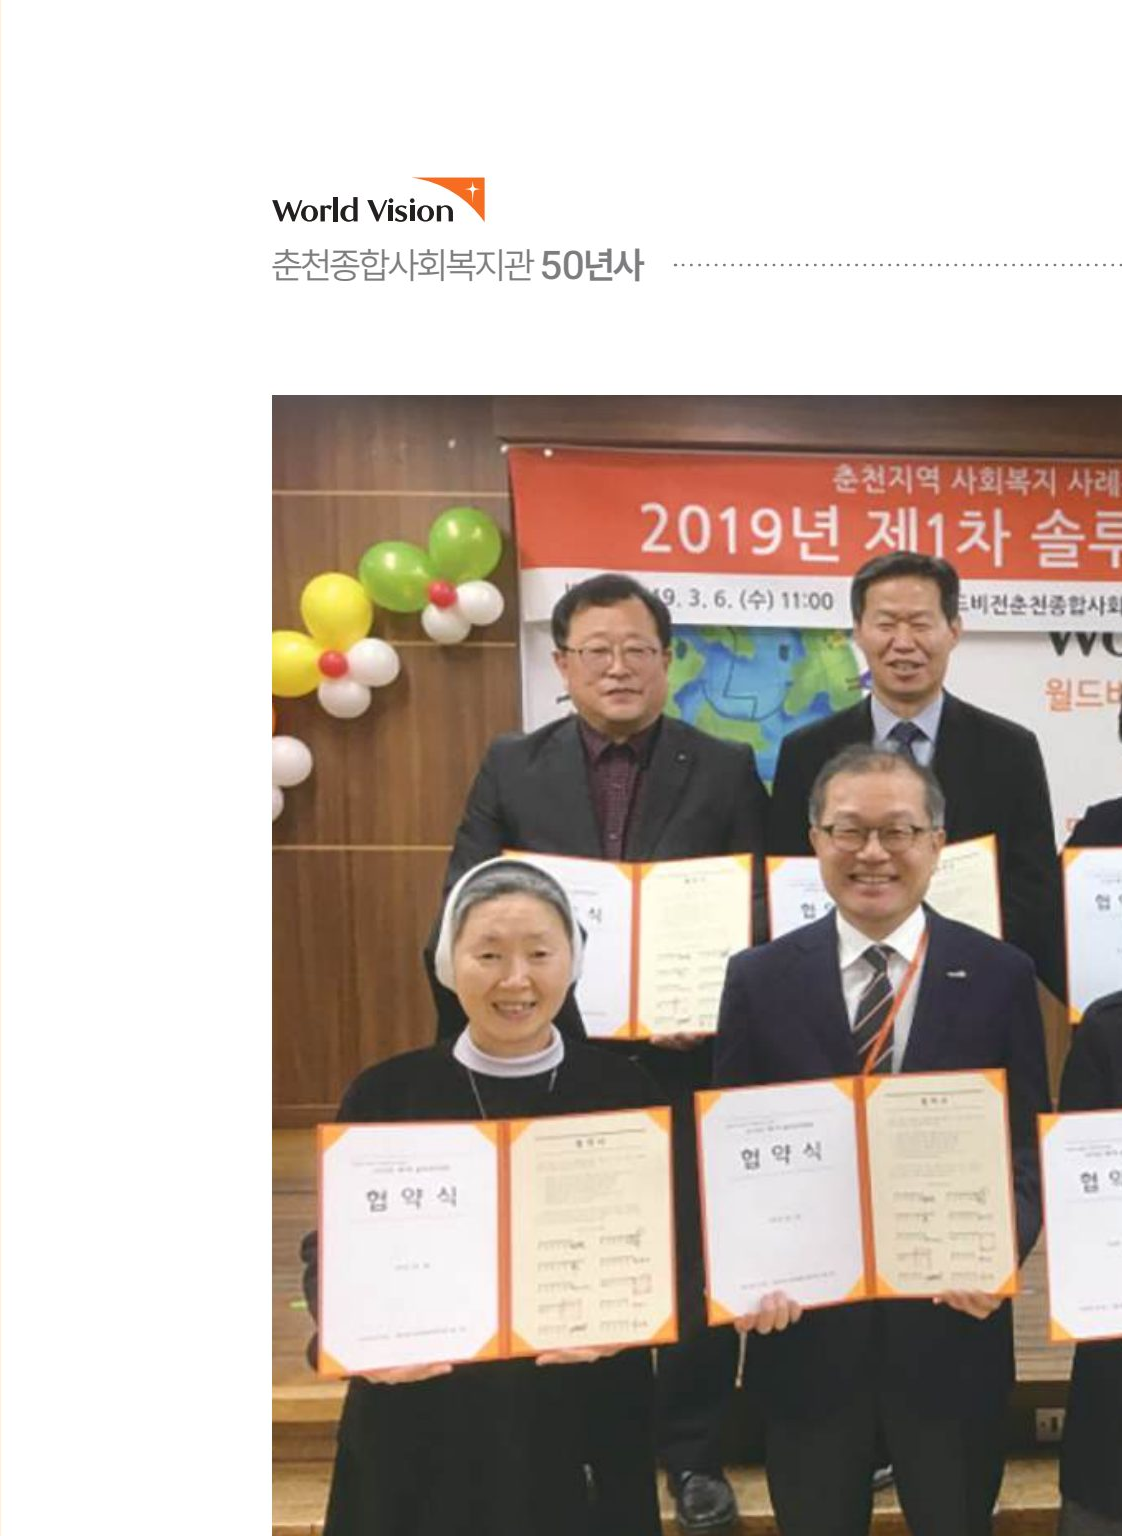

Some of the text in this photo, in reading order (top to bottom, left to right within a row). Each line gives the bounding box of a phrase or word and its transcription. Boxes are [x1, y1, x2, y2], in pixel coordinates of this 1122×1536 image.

[832, 464, 940, 496] 춘천지역
[951, 465, 1058, 498] 사회복지
[640, 502, 840, 563] 2019년
[866, 507, 1009, 567] 제1차
[740, 589, 774, 610] (수)
[783, 592, 834, 610] 11:00
